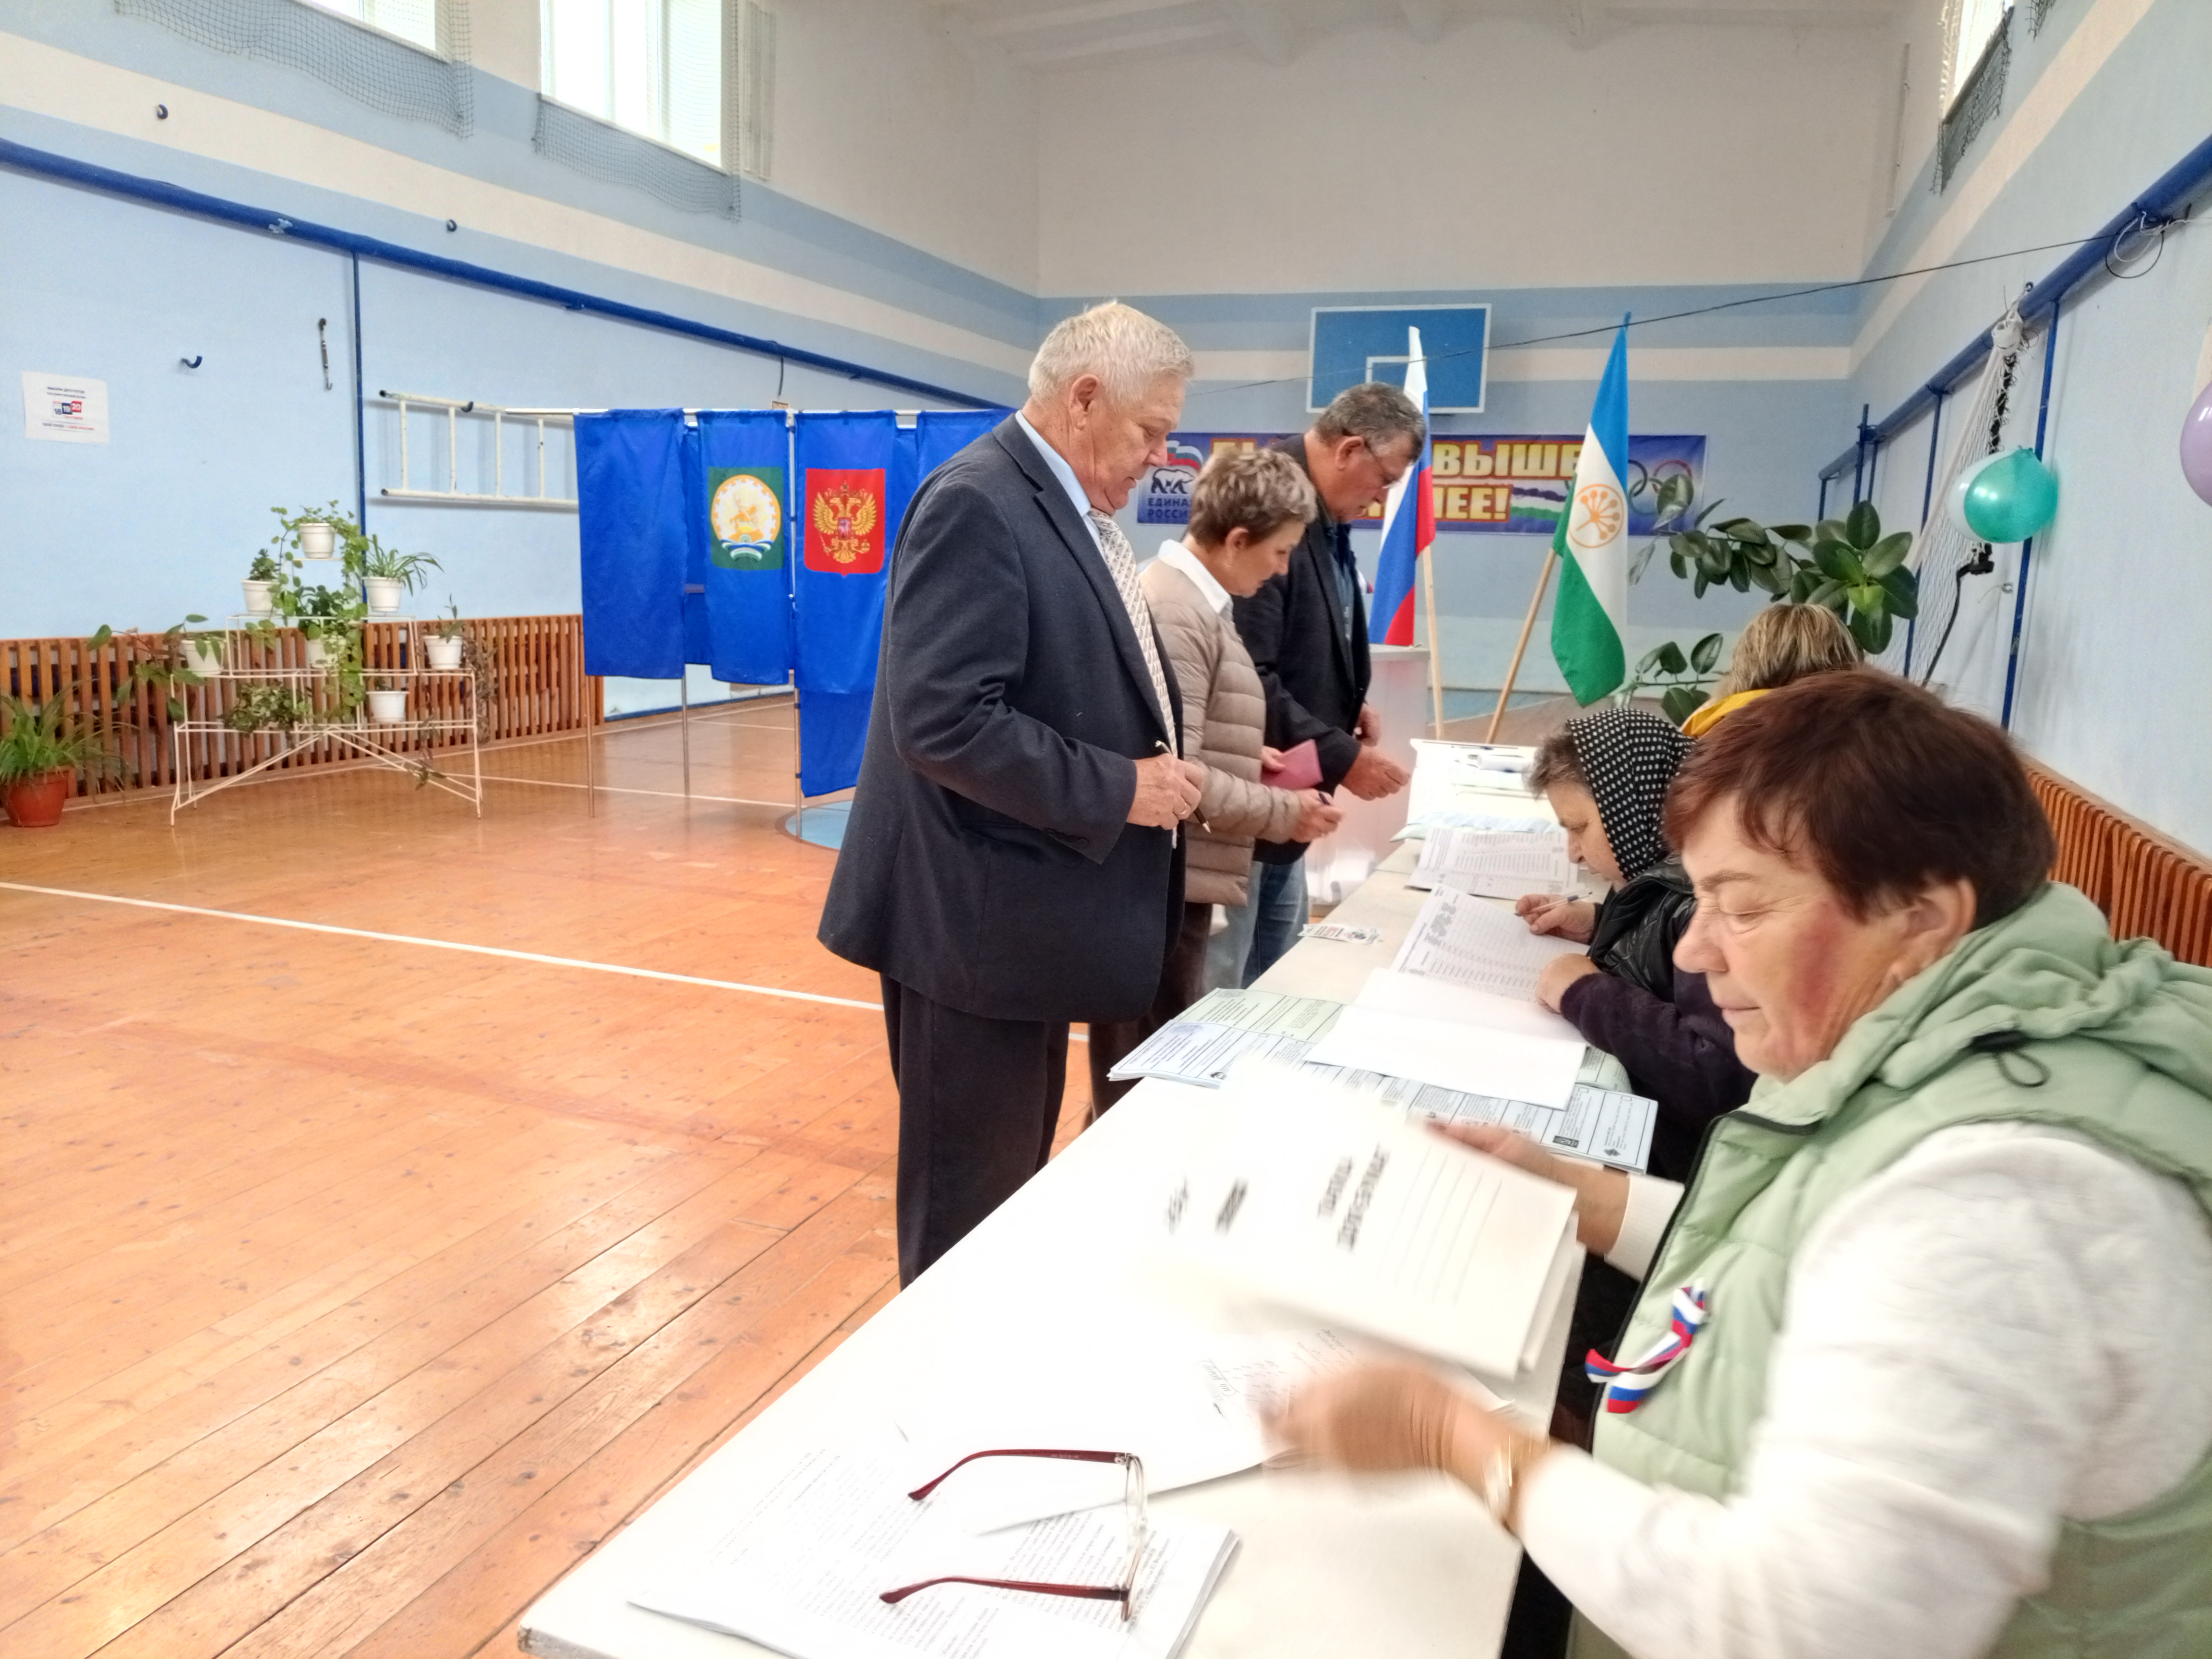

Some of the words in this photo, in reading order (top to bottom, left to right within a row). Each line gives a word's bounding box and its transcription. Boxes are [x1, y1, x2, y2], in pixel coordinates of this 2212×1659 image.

[71, 402, 82, 411] 20
[1148, 497, 1190, 507] ЕДИНА
[1148, 509, 1189, 518] РОССИ
